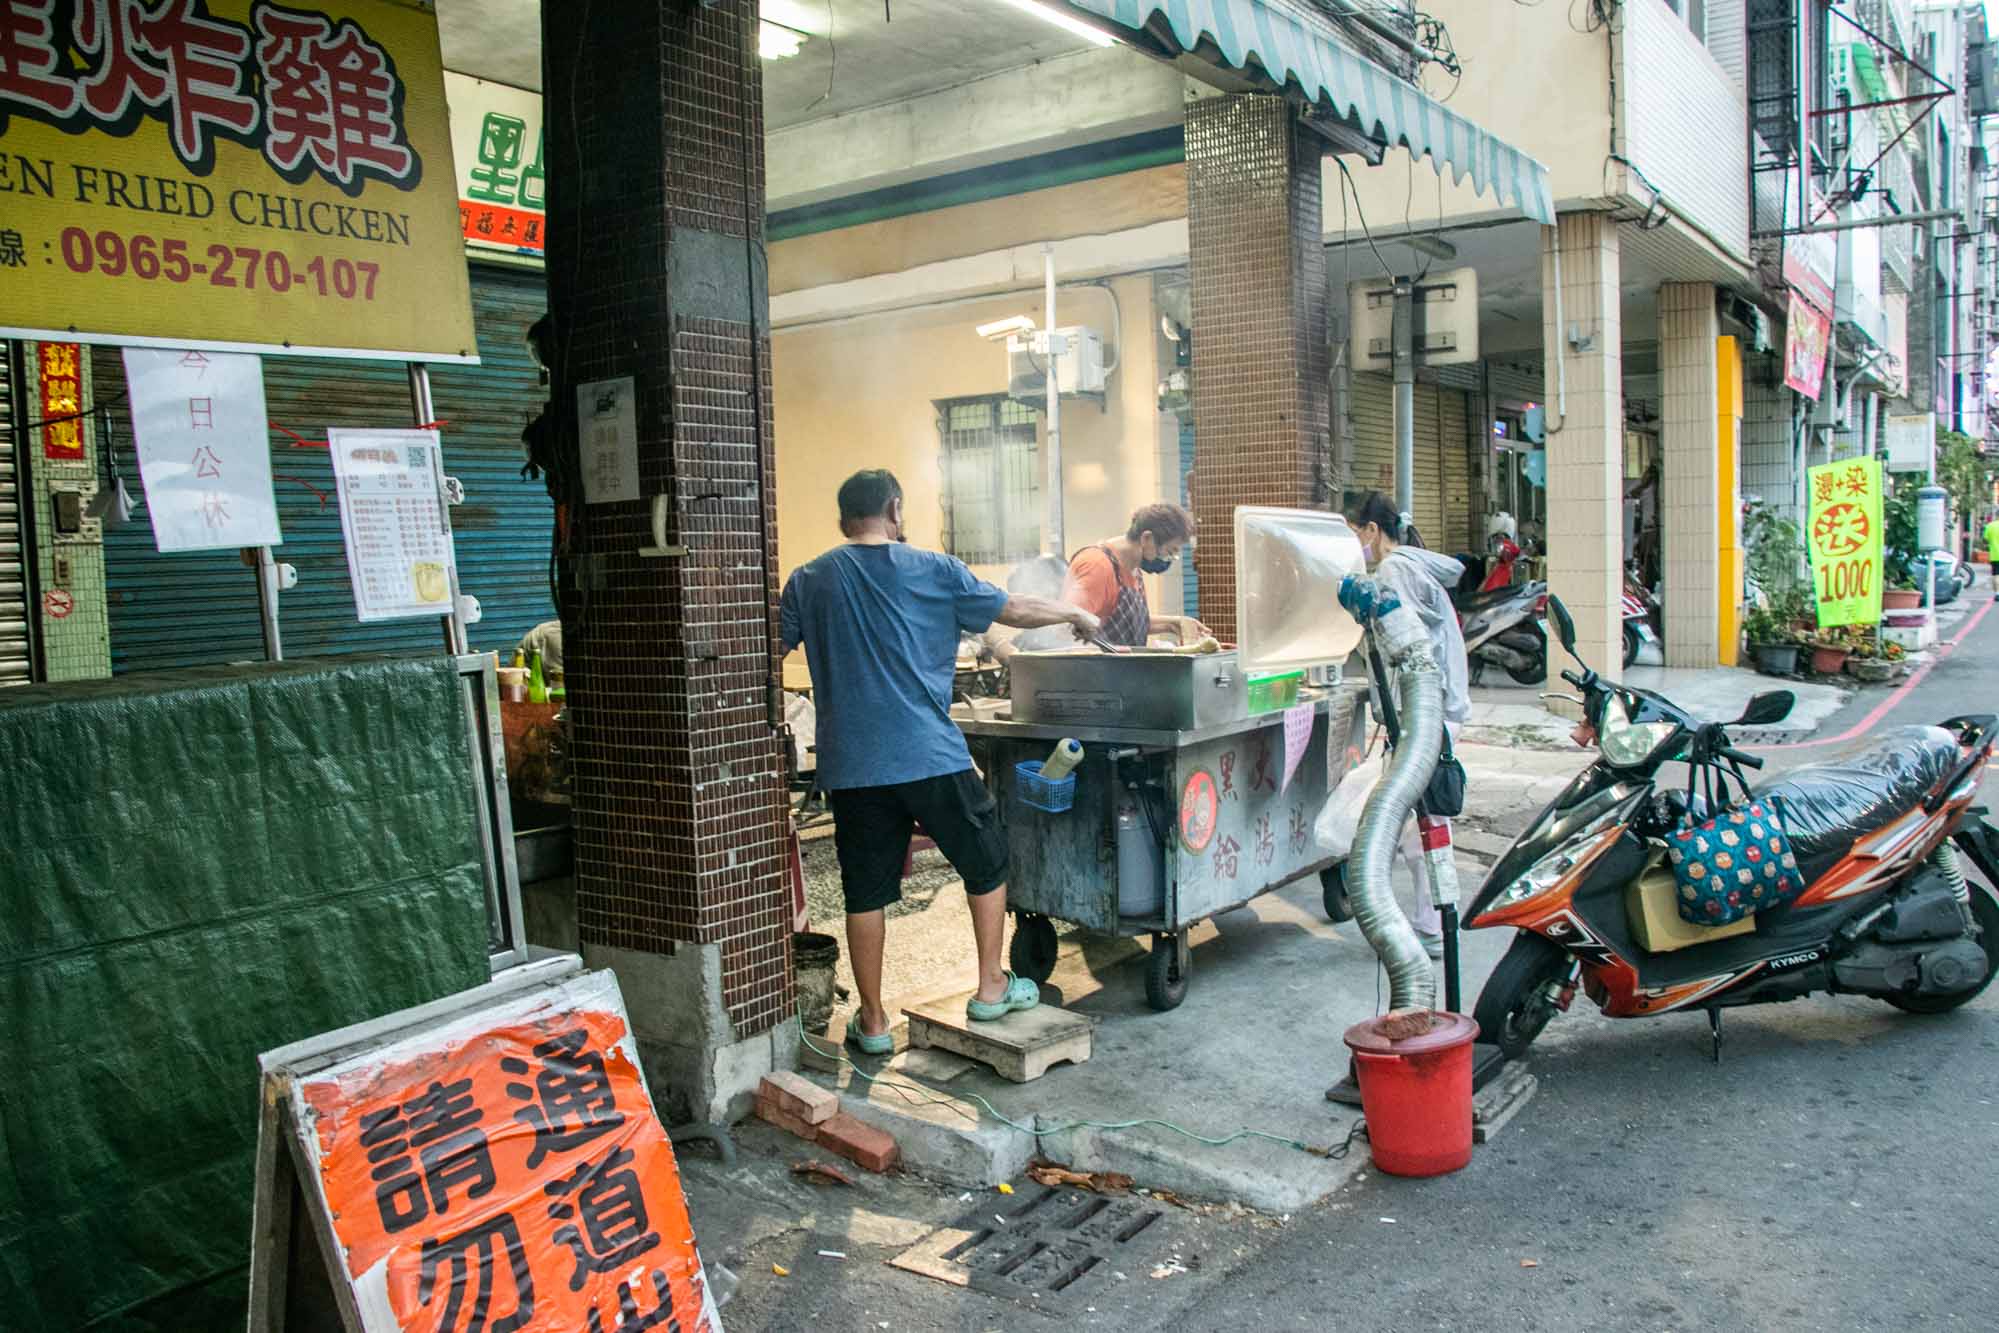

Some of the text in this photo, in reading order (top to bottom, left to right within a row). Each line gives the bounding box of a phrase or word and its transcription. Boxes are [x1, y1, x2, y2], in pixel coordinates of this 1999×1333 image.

[72, 164, 214, 220] FRIED
[229, 189, 410, 246] CHICKEN
[61, 227, 380, 301] 0965-270-107
[179, 350, 231, 529] 今日公休
[1820, 559, 1872, 603] 1000
[1770, 951, 1819, 969] KYMCO
[360, 1078, 535, 1333] 請勿
